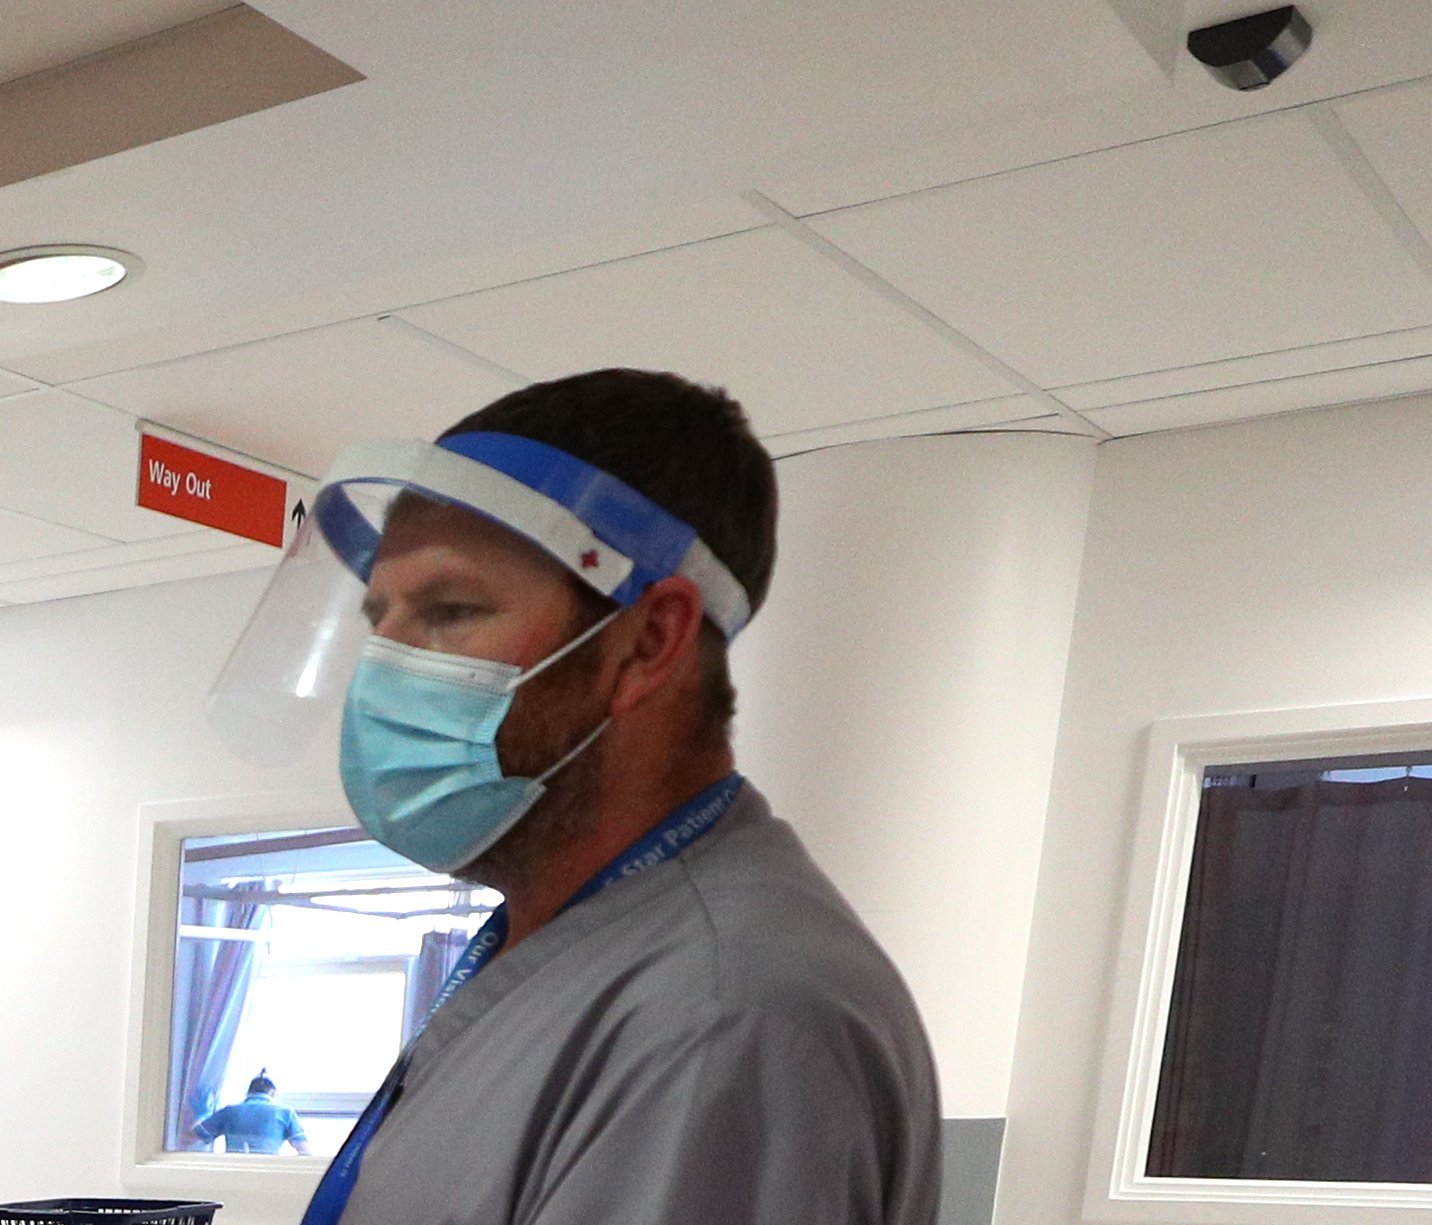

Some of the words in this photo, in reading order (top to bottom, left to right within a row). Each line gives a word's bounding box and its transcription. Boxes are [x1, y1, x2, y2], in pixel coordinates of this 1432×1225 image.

[148, 458, 181, 496] Way
[186, 472, 212, 499] Out
[468, 932, 499, 964] Our
